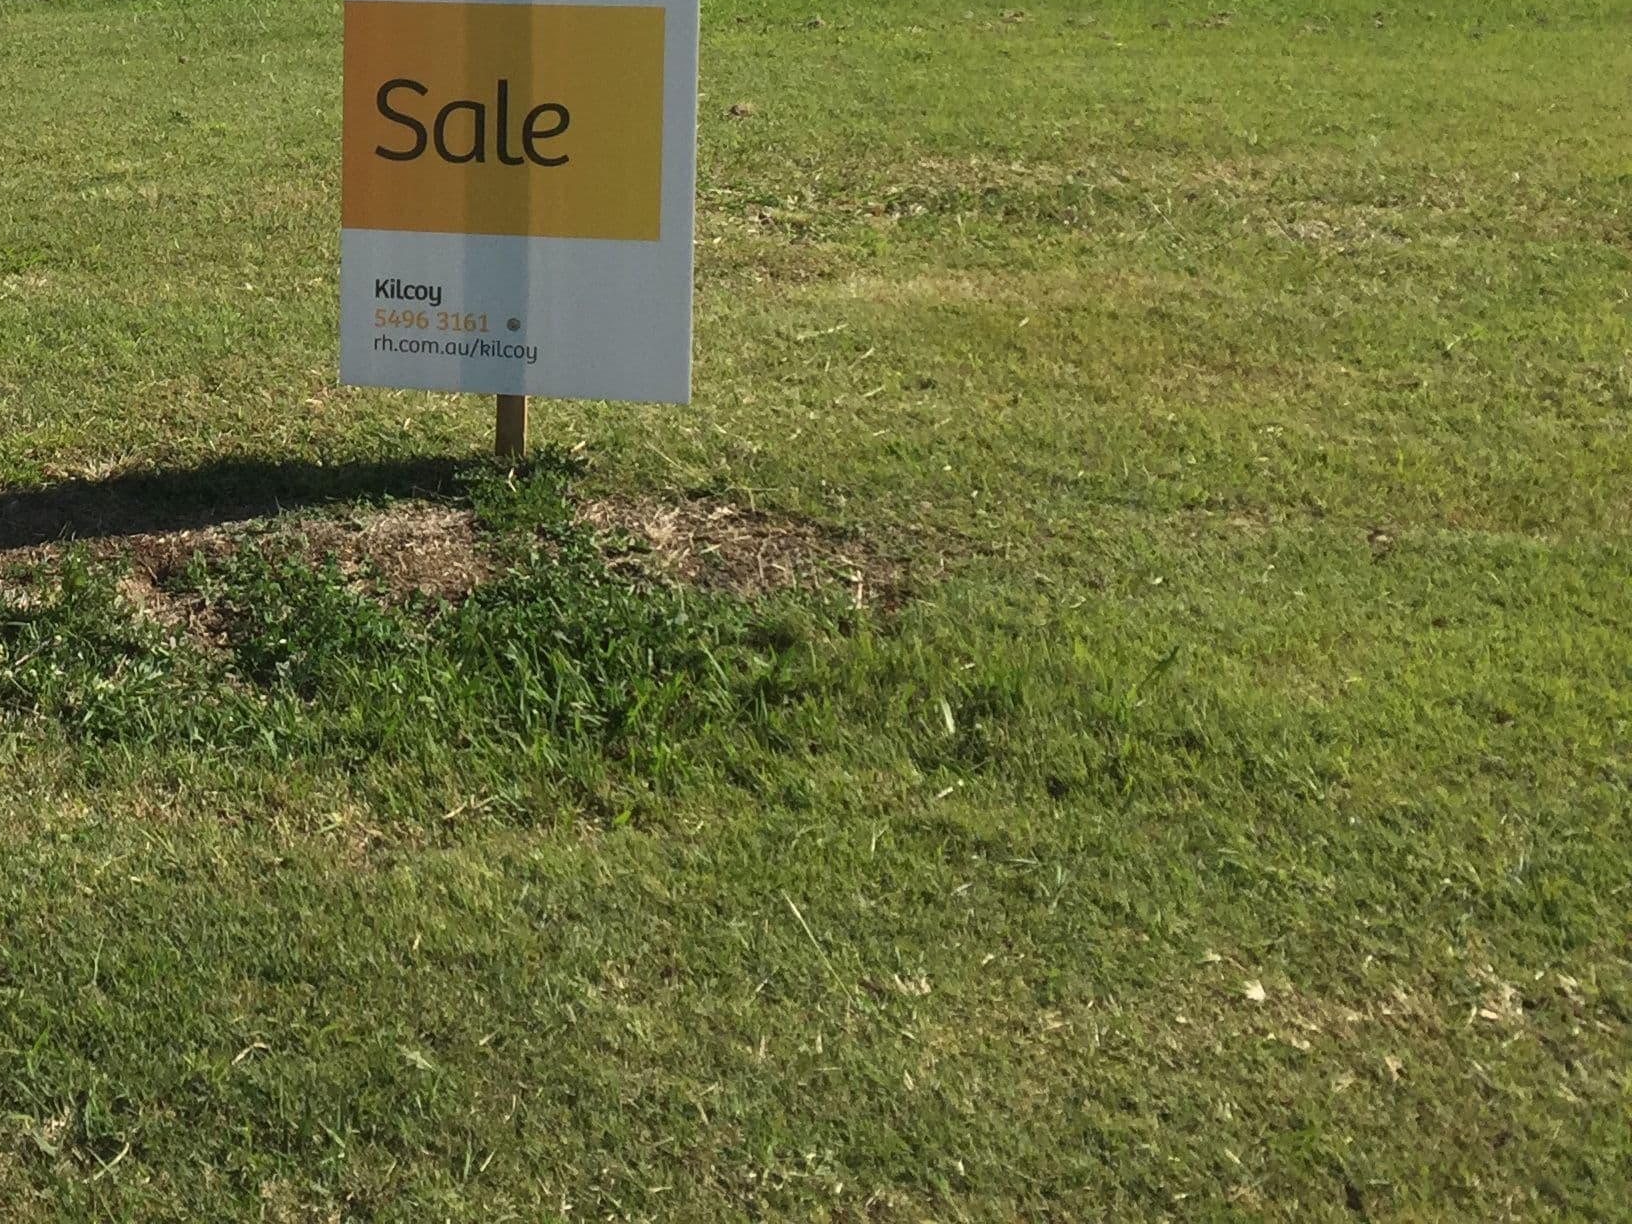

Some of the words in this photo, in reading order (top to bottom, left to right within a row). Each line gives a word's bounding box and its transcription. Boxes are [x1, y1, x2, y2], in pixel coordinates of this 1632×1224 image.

[375, 79, 570, 167] Sale
[375, 278, 442, 306] Kilcoy
[374, 308, 429, 329] 5496
[436, 311, 490, 333] 3161
[374, 334, 538, 364] rh.com.au/kilcoy
